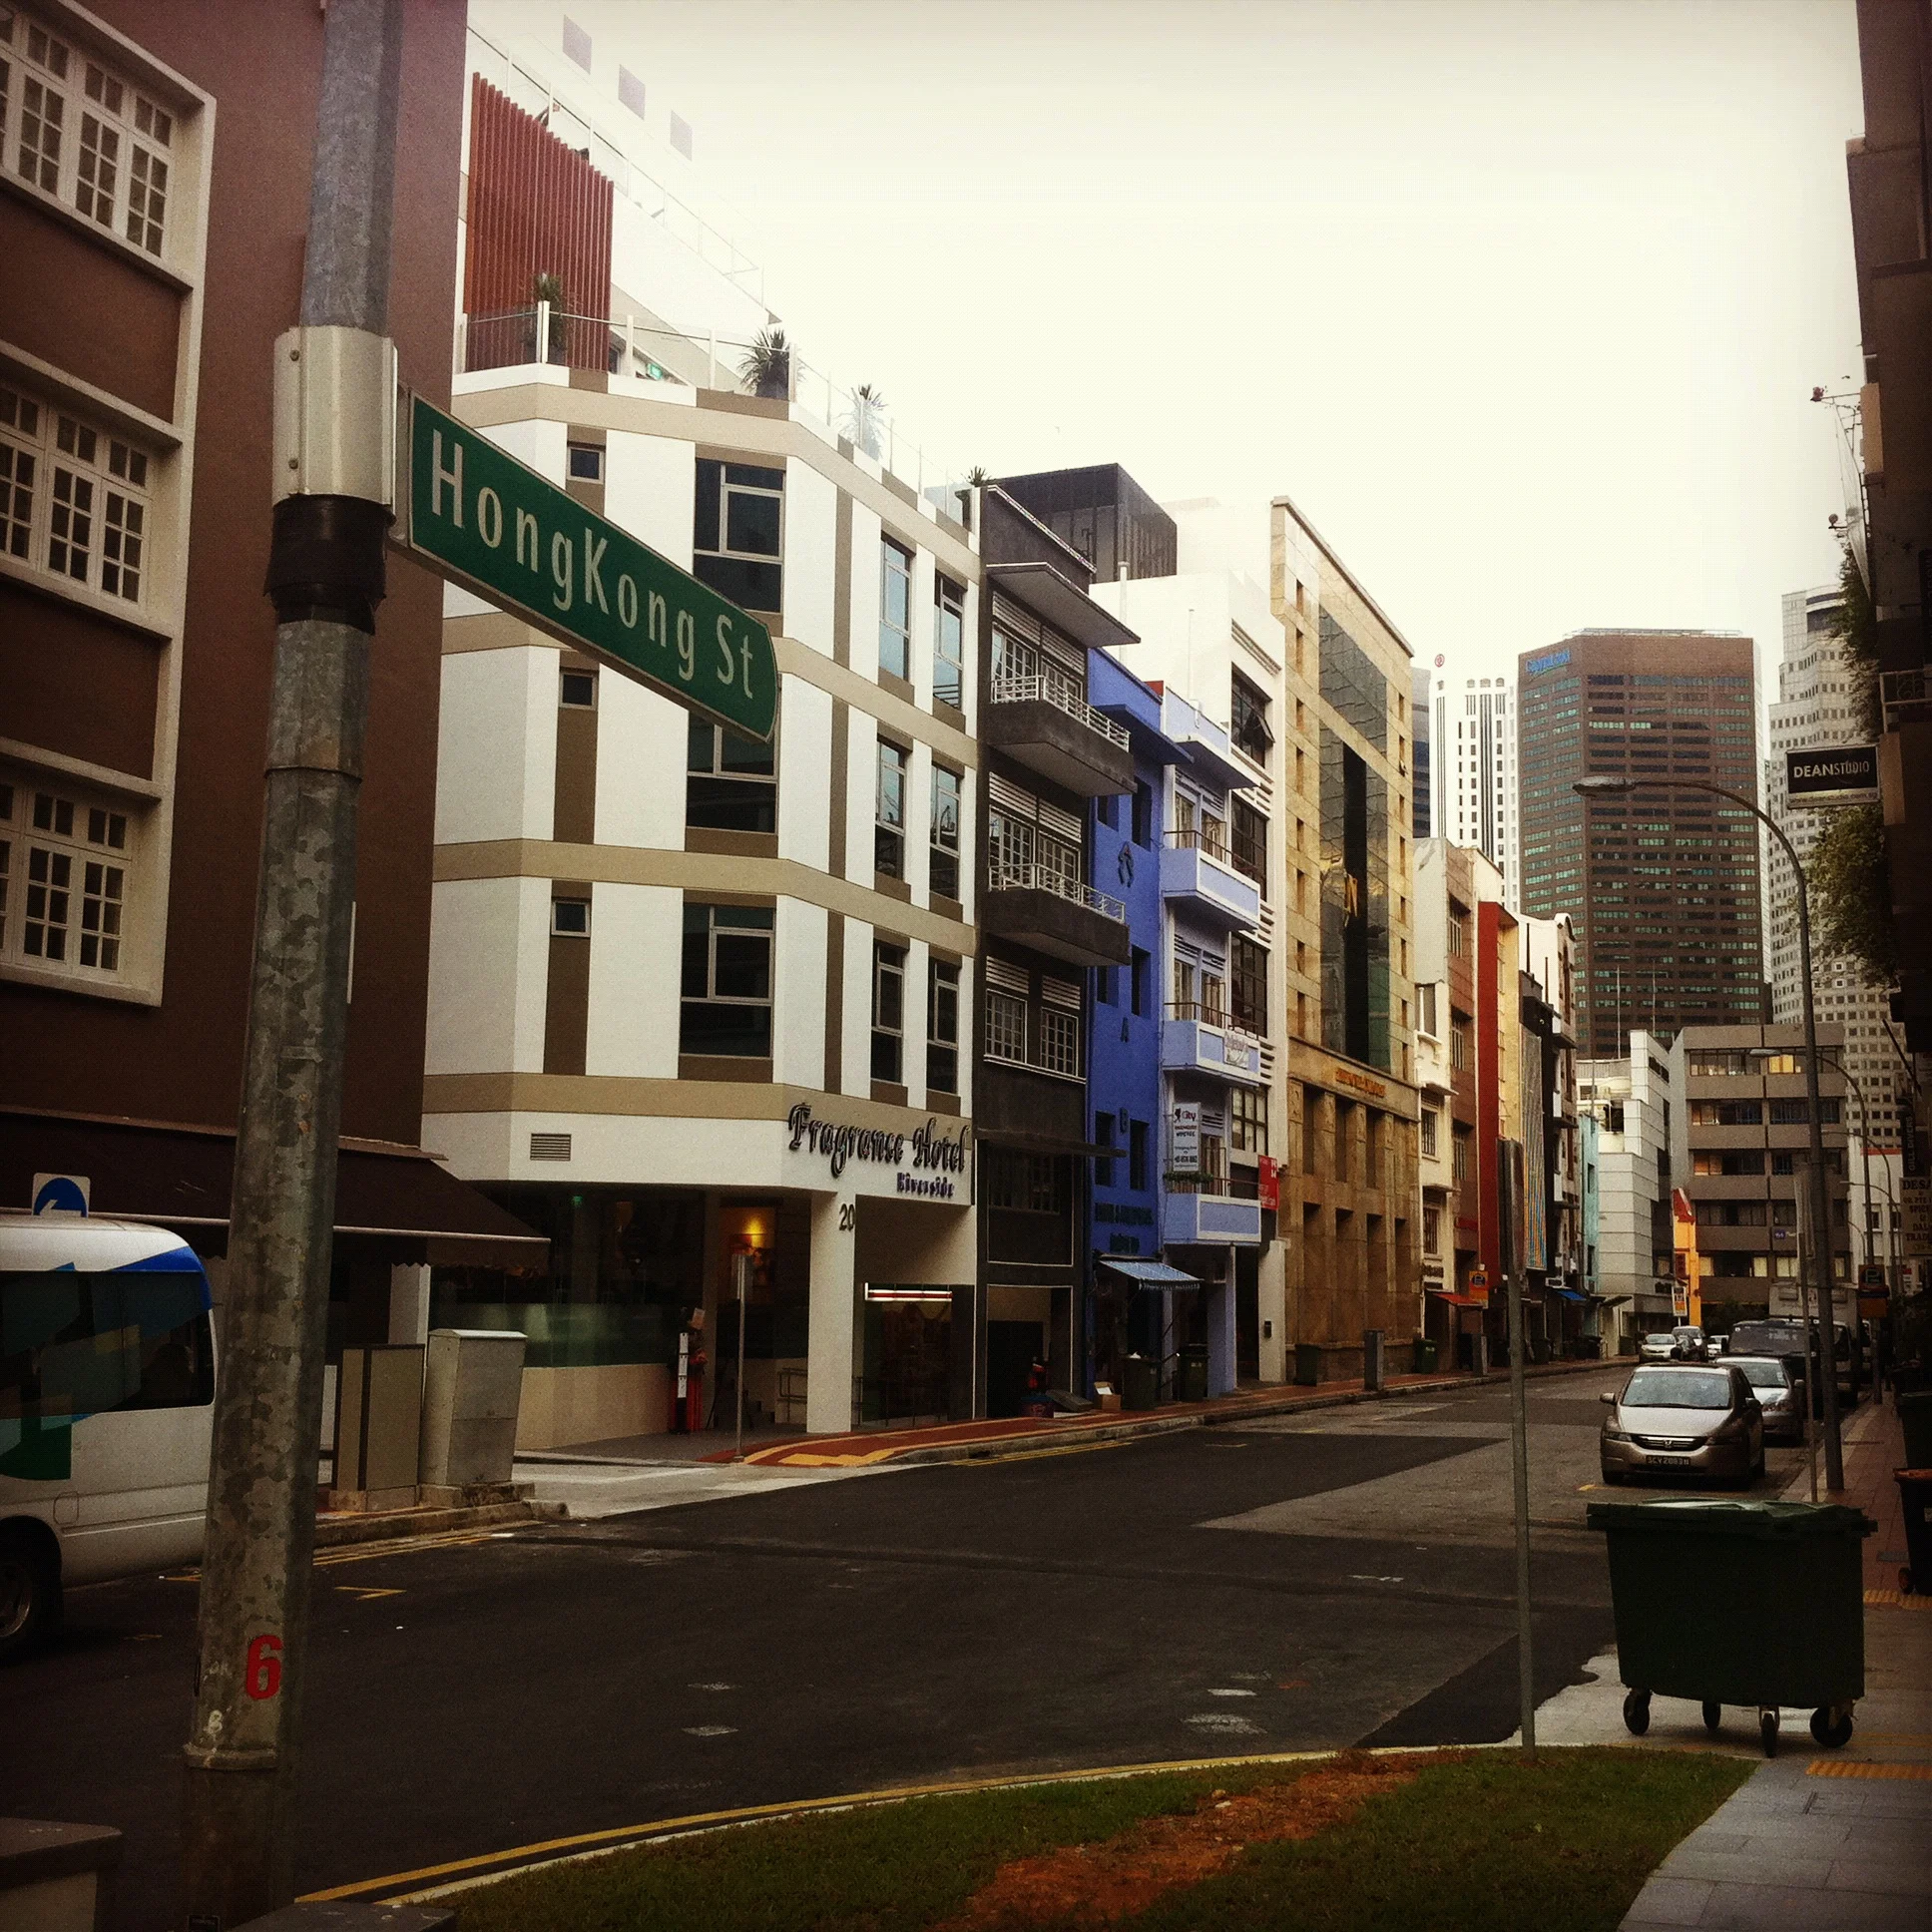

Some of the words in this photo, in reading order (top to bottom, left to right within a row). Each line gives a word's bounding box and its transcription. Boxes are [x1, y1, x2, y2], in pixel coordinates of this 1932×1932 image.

[432, 429, 695, 681] HongKong
[717, 615, 753, 699] St
[788, 1102, 905, 1179] Fragrance
[912, 1116, 971, 1174] Hotel
[838, 1204, 855, 1230] 20
[896, 1173, 955, 1198] Riverside
[245, 1634, 284, 1699] 6
